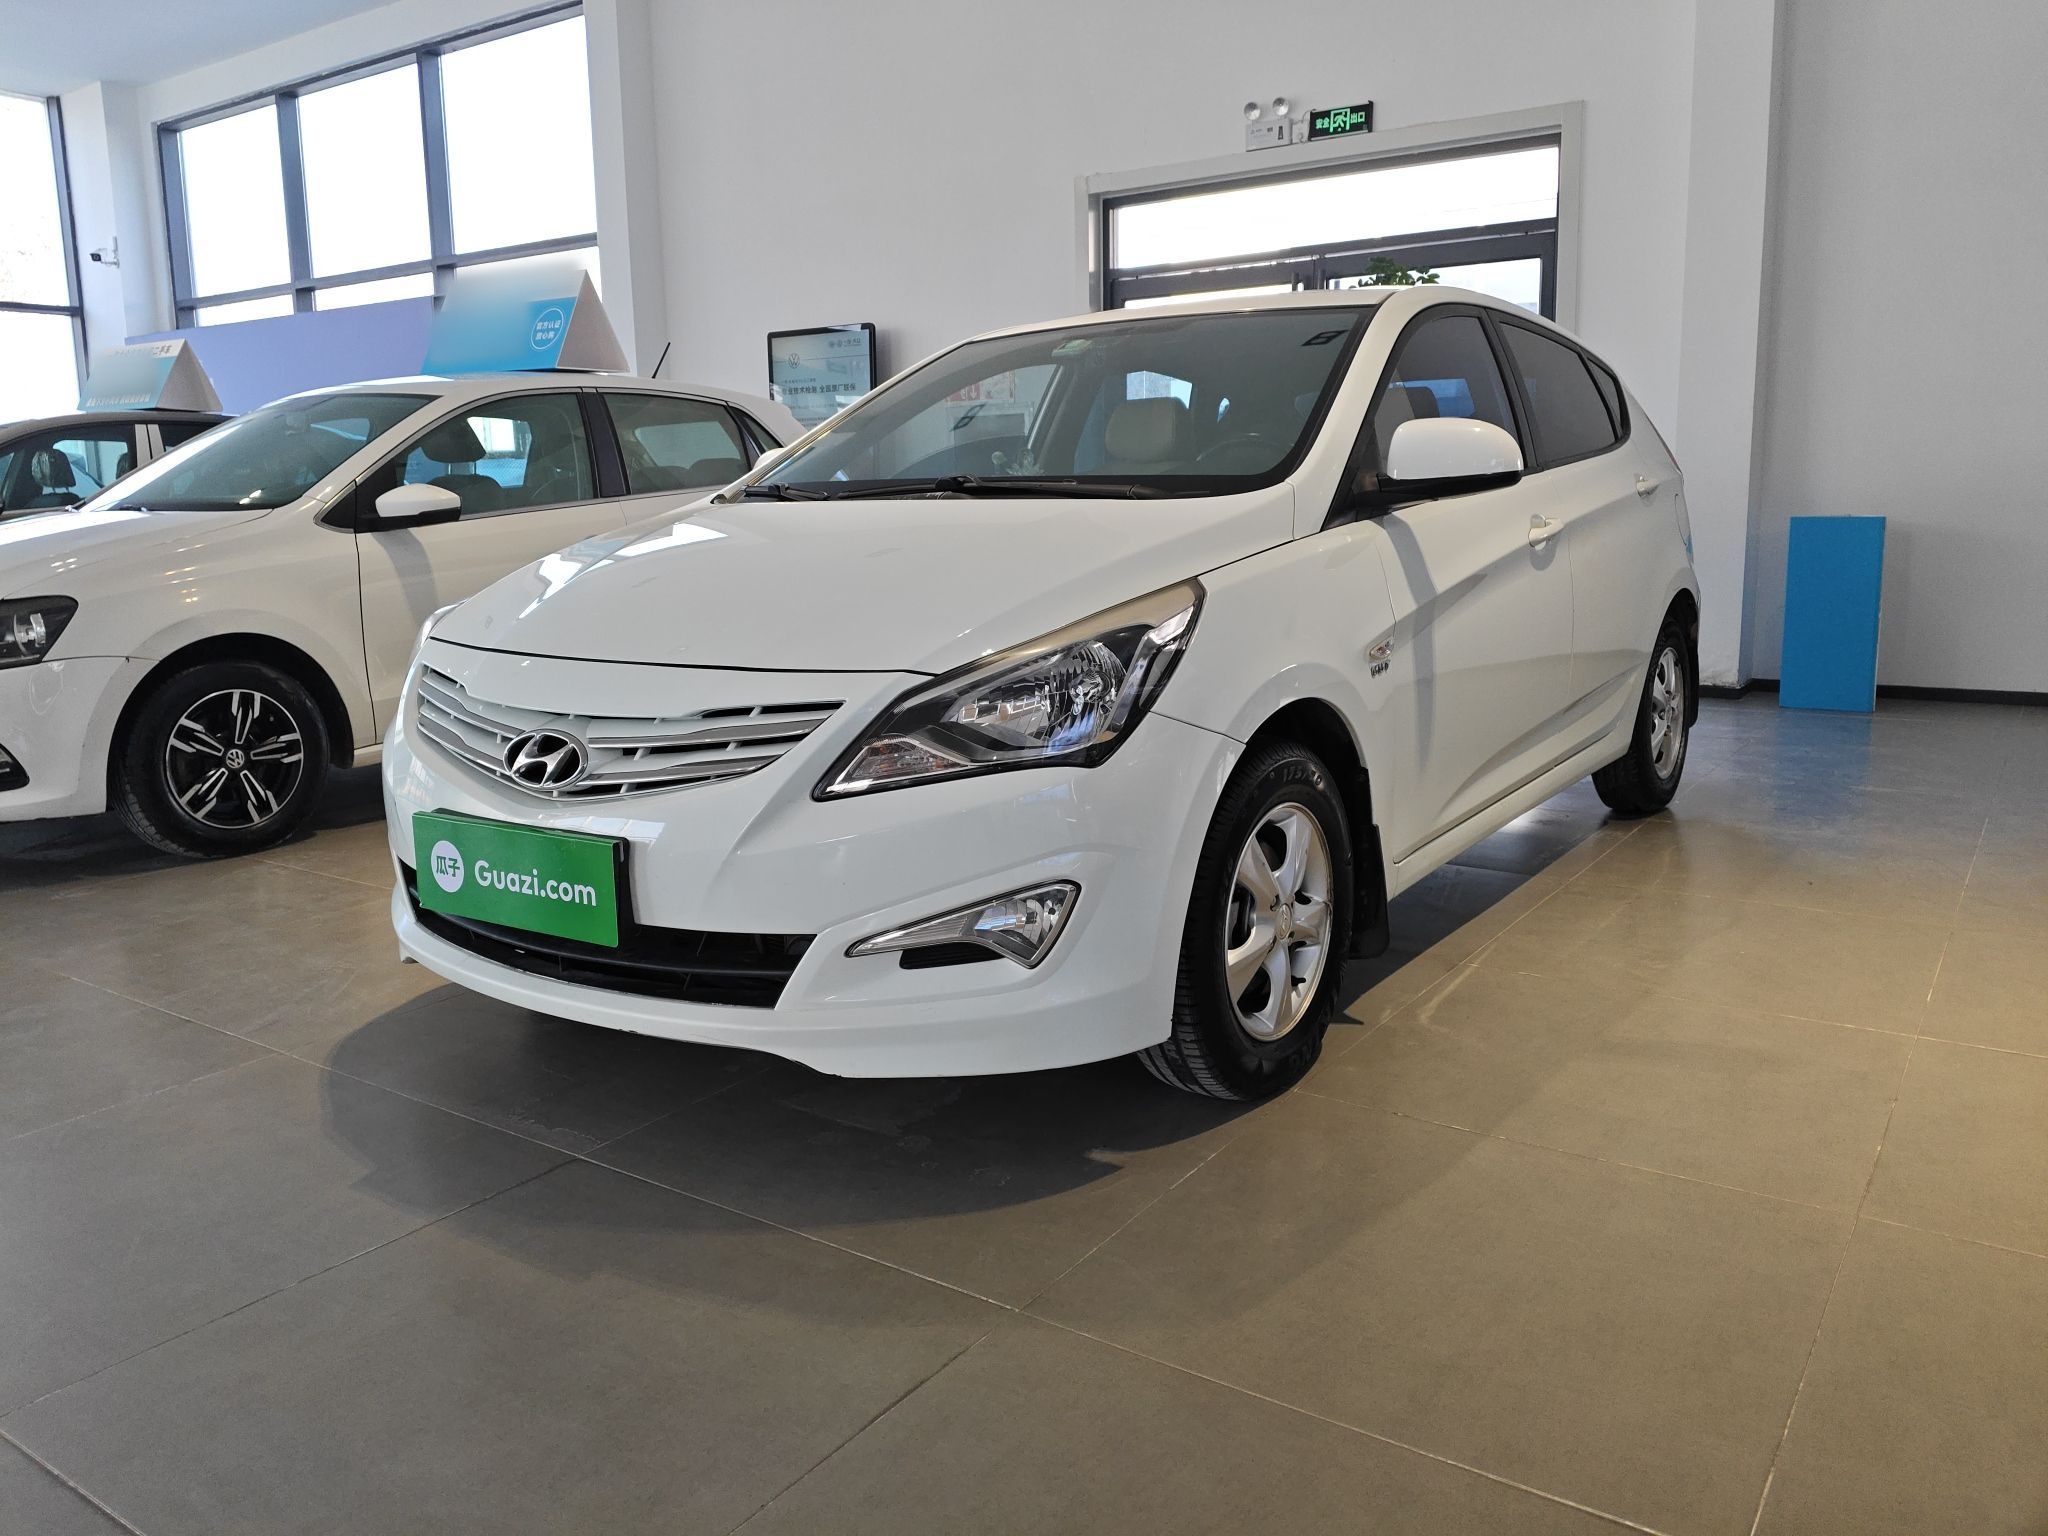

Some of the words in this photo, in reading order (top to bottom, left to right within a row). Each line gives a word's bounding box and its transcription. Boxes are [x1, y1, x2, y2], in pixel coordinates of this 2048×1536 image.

[1315, 117, 1330, 129] 安全
[1350, 112, 1366, 124] 出口
[436, 855, 460, 877] 瓜子
[474, 860, 596, 906] Guazi.com
